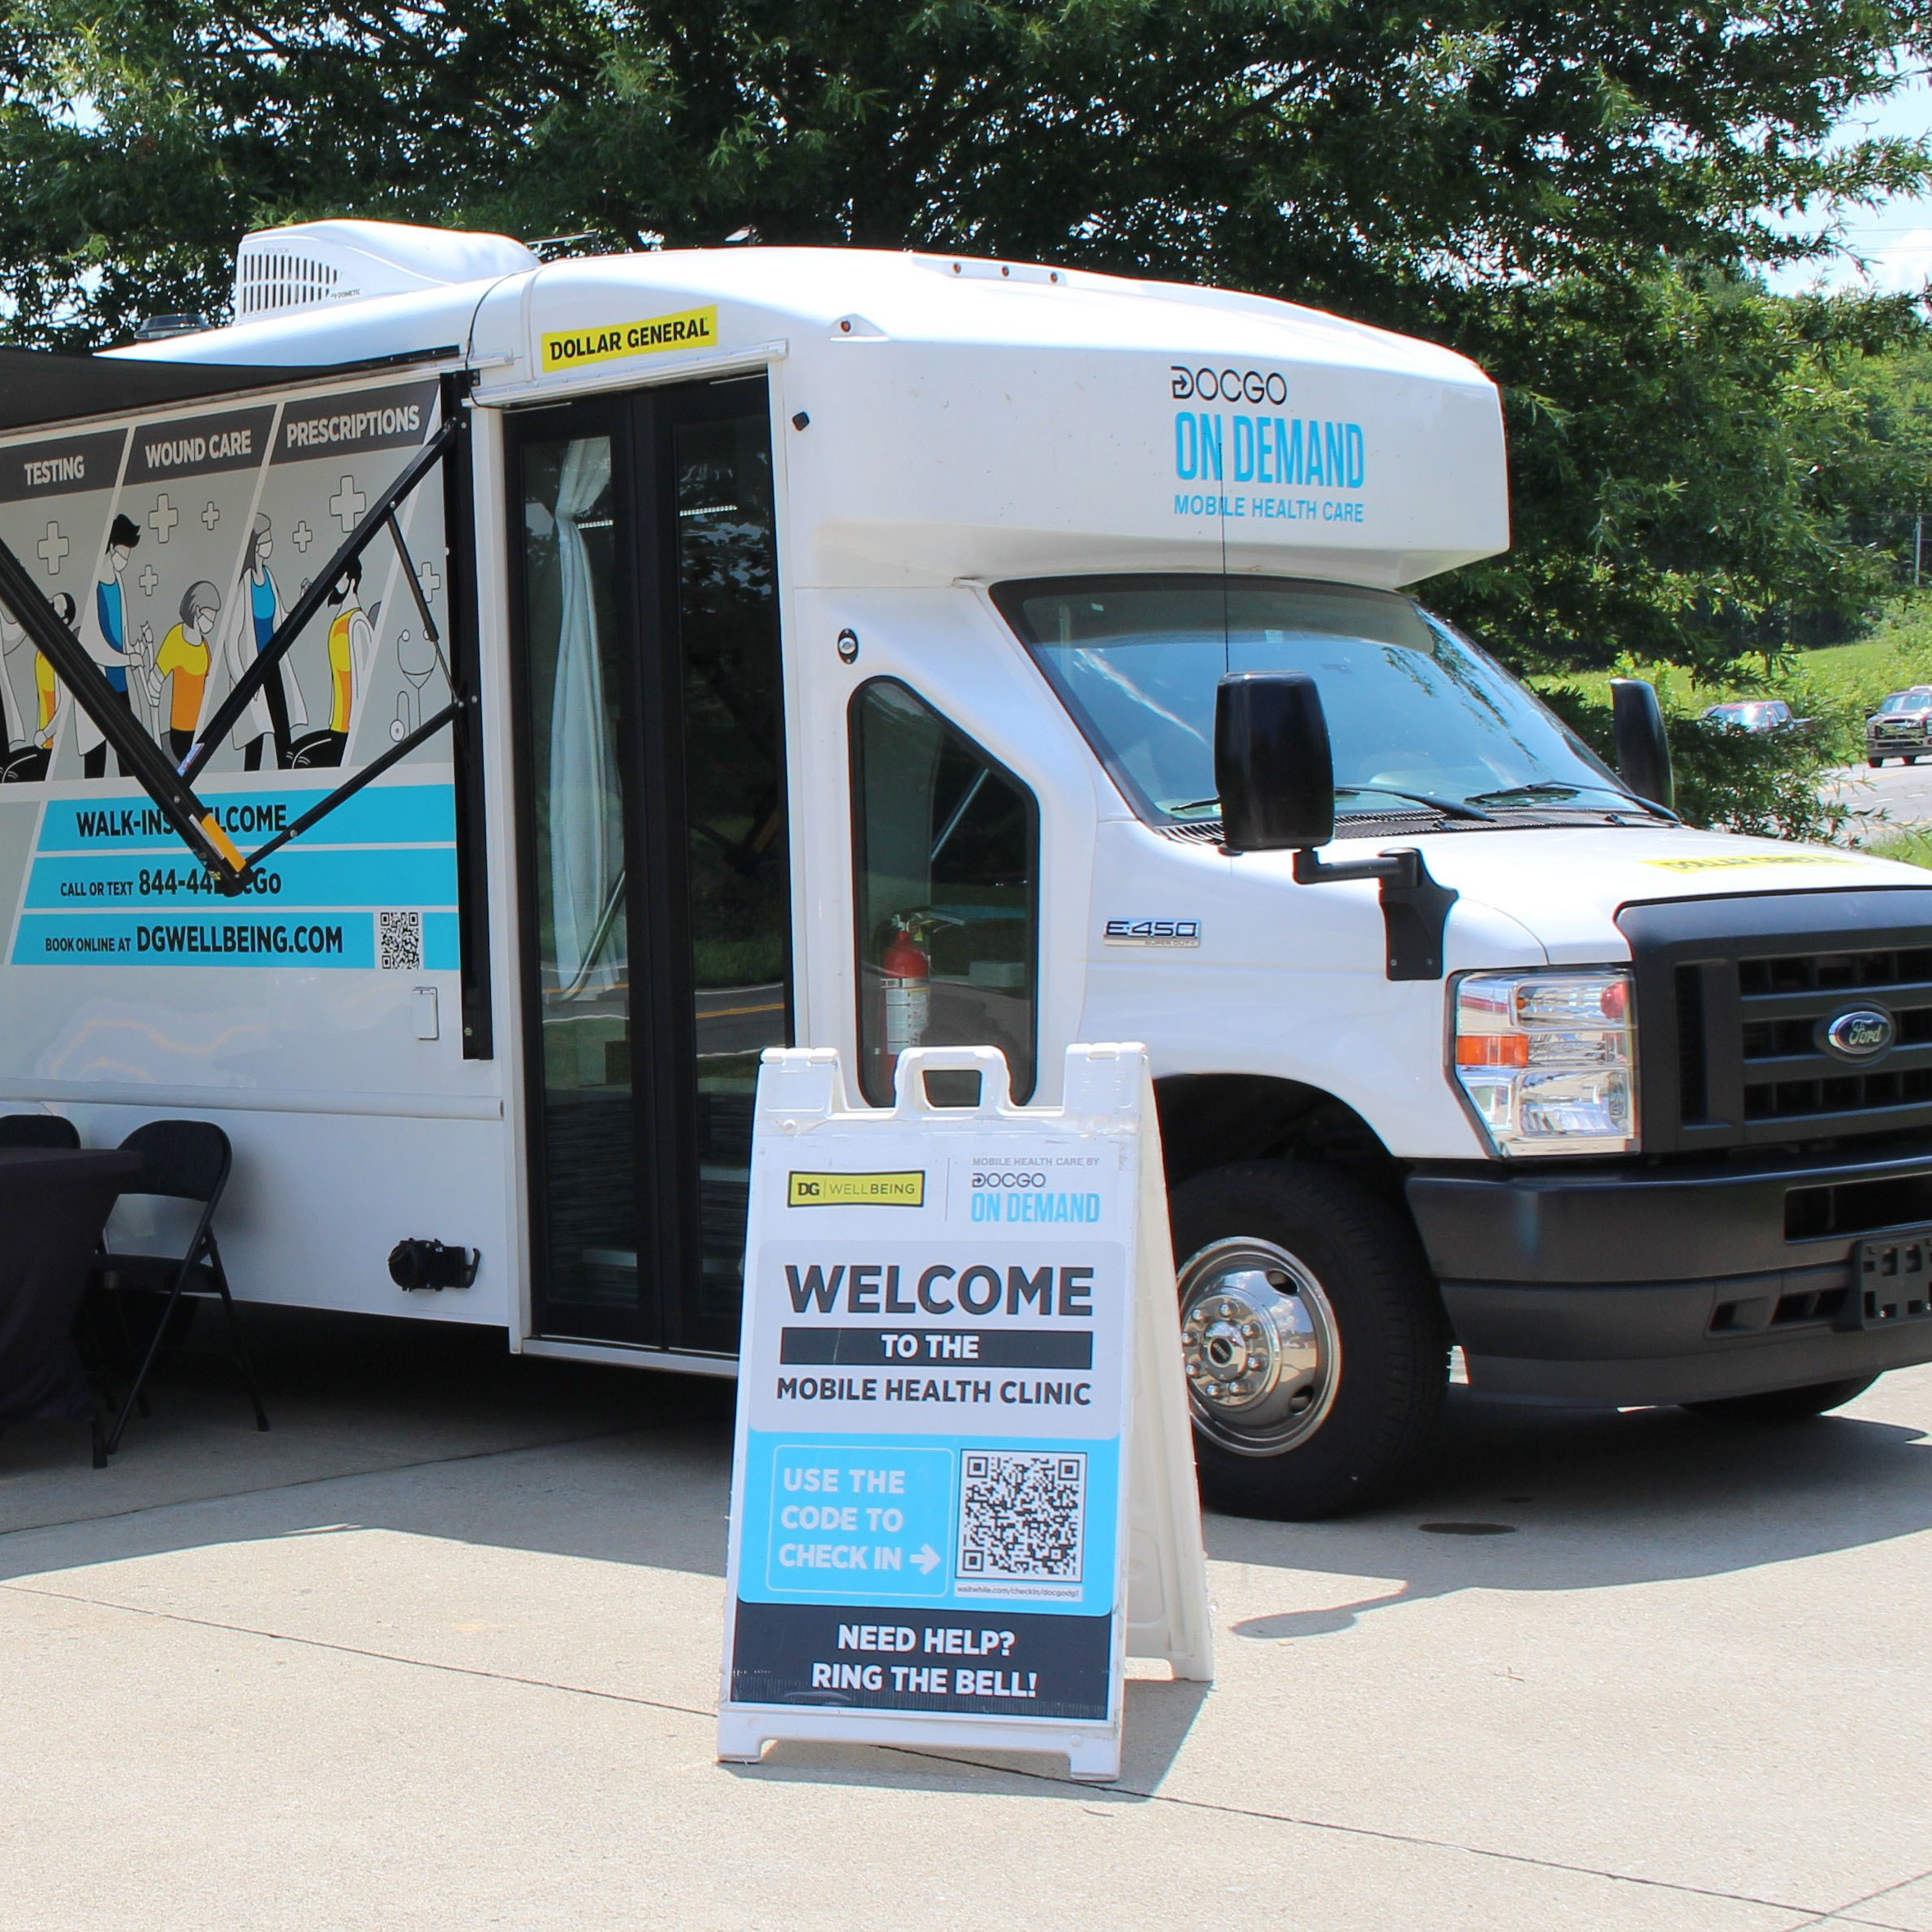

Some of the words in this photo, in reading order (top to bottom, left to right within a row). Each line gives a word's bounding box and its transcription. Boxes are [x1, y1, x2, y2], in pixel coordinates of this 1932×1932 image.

[550, 332, 621, 361] DOLLAR
[627, 318, 710, 348] GENERAL
[1171, 366, 1287, 405] DOCGO
[286, 405, 420, 448] PRESCRIPTIONS
[145, 434, 205, 468] WOUND
[210, 430, 251, 457] CARE
[1175, 411, 1222, 481] ON
[1233, 415, 1365, 489] DEMAND
[25, 457, 84, 486] TESTING
[1175, 495, 1244, 516] MOBILE
[1252, 498, 1316, 519] HEALTH
[1323, 502, 1364, 522] CARE
[61, 882, 86, 896] CALL
[89, 882, 104, 896] OR
[107, 881, 133, 895] TEXT
[45, 938, 75, 952] BOOK
[76, 937, 115, 952] ONLINE
[118, 937, 131, 951] AT
[137, 925, 343, 953] DGWELLBEING.COM
[1106, 921, 1197, 936] E-450
[1849, 1019, 1882, 1045] Ford
[972, 1157, 1011, 1166] MOBILE
[1014, 1157, 1053, 1166] HEALTH
[1056, 1157, 1084, 1166] CARE
[1086, 1157, 1099, 1166] BY
[798, 1183, 820, 1196] DG
[830, 1183, 915, 1195] WELLBEING
[972, 1172, 1046, 1189] DOCGO
[971, 1193, 1001, 1222] ON
[1007, 1193, 1100, 1223] DEMAND
[784, 1264, 1094, 1316] WELCOME
[881, 1334, 918, 1358] TO
[925, 1334, 980, 1360] THE
[776, 1377, 877, 1401] MOBILE
[885, 1379, 989, 1403] HEALTH
[999, 1381, 1091, 1406] CLINIC
[783, 1468, 839, 1493] USE
[848, 1469, 905, 1494] THE
[781, 1505, 857, 1531] CODE
[865, 1507, 903, 1532] TO
[778, 1543, 867, 1570] CHECK
[873, 1545, 901, 1571] IN
[837, 1624, 916, 1652] NEED
[923, 1627, 1016, 1657] HELP?
[811, 1663, 883, 1691] RING
[889, 1666, 948, 1694] THE
[954, 1669, 1038, 1698] BELL!
